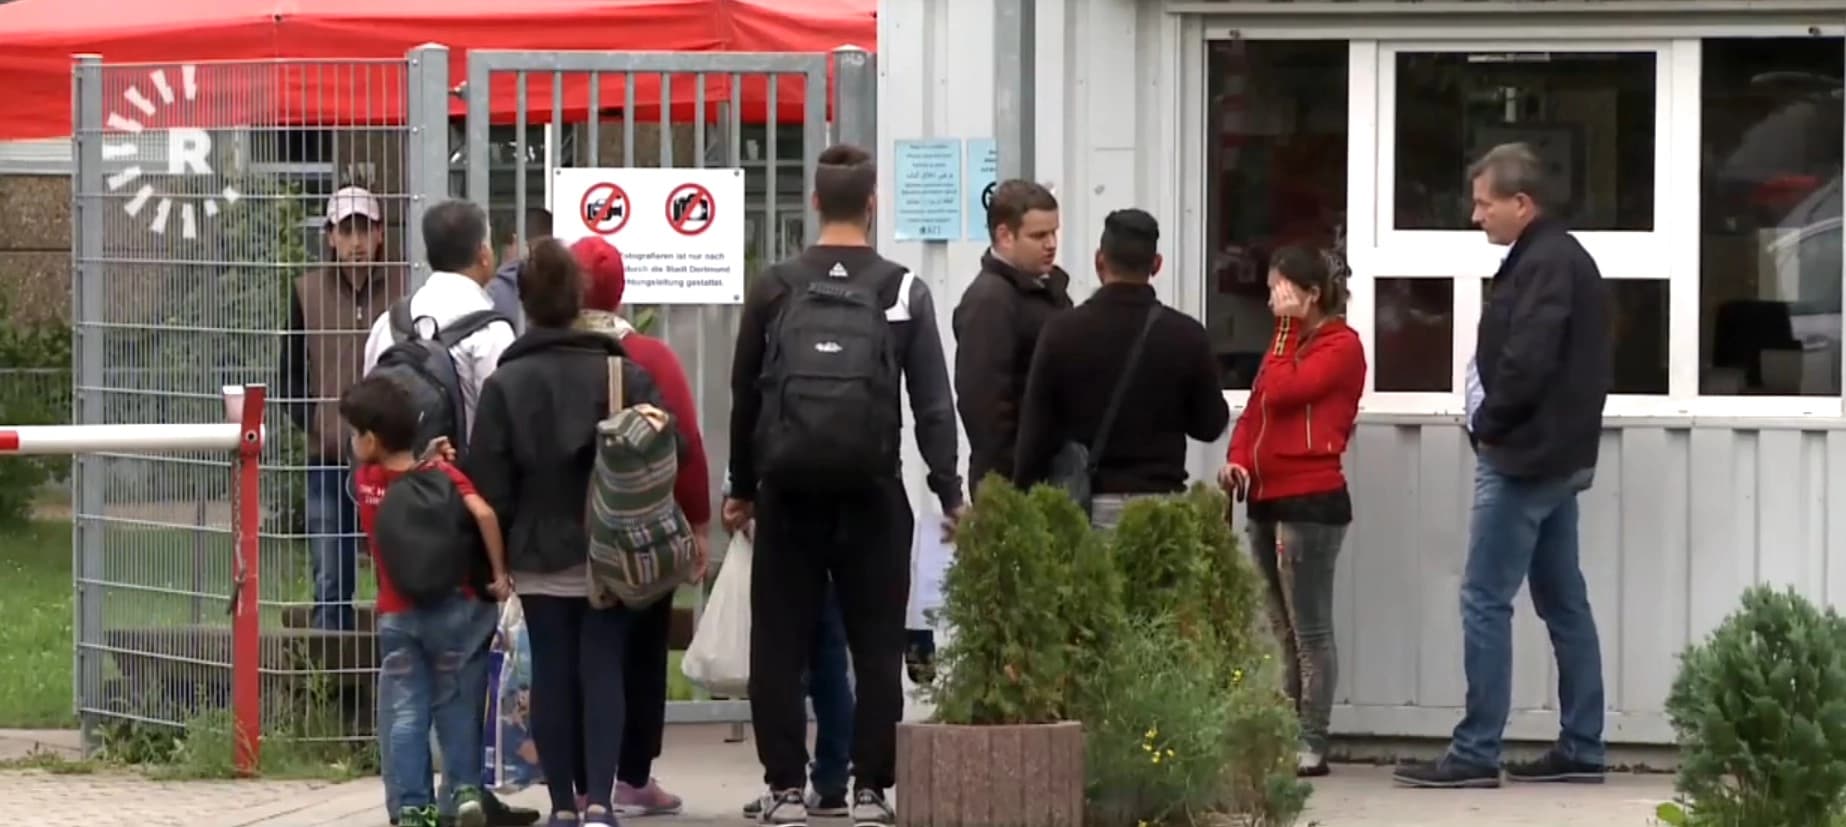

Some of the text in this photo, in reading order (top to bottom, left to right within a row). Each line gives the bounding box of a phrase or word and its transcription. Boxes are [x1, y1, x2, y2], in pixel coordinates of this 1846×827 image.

[624, 252, 674, 261] otografieren
[676, 252, 687, 260] ist
[704, 252, 725, 261] nach
[651, 265, 663, 273] die
[666, 265, 687, 273] Stadt
[689, 265, 731, 274] Dortmund
